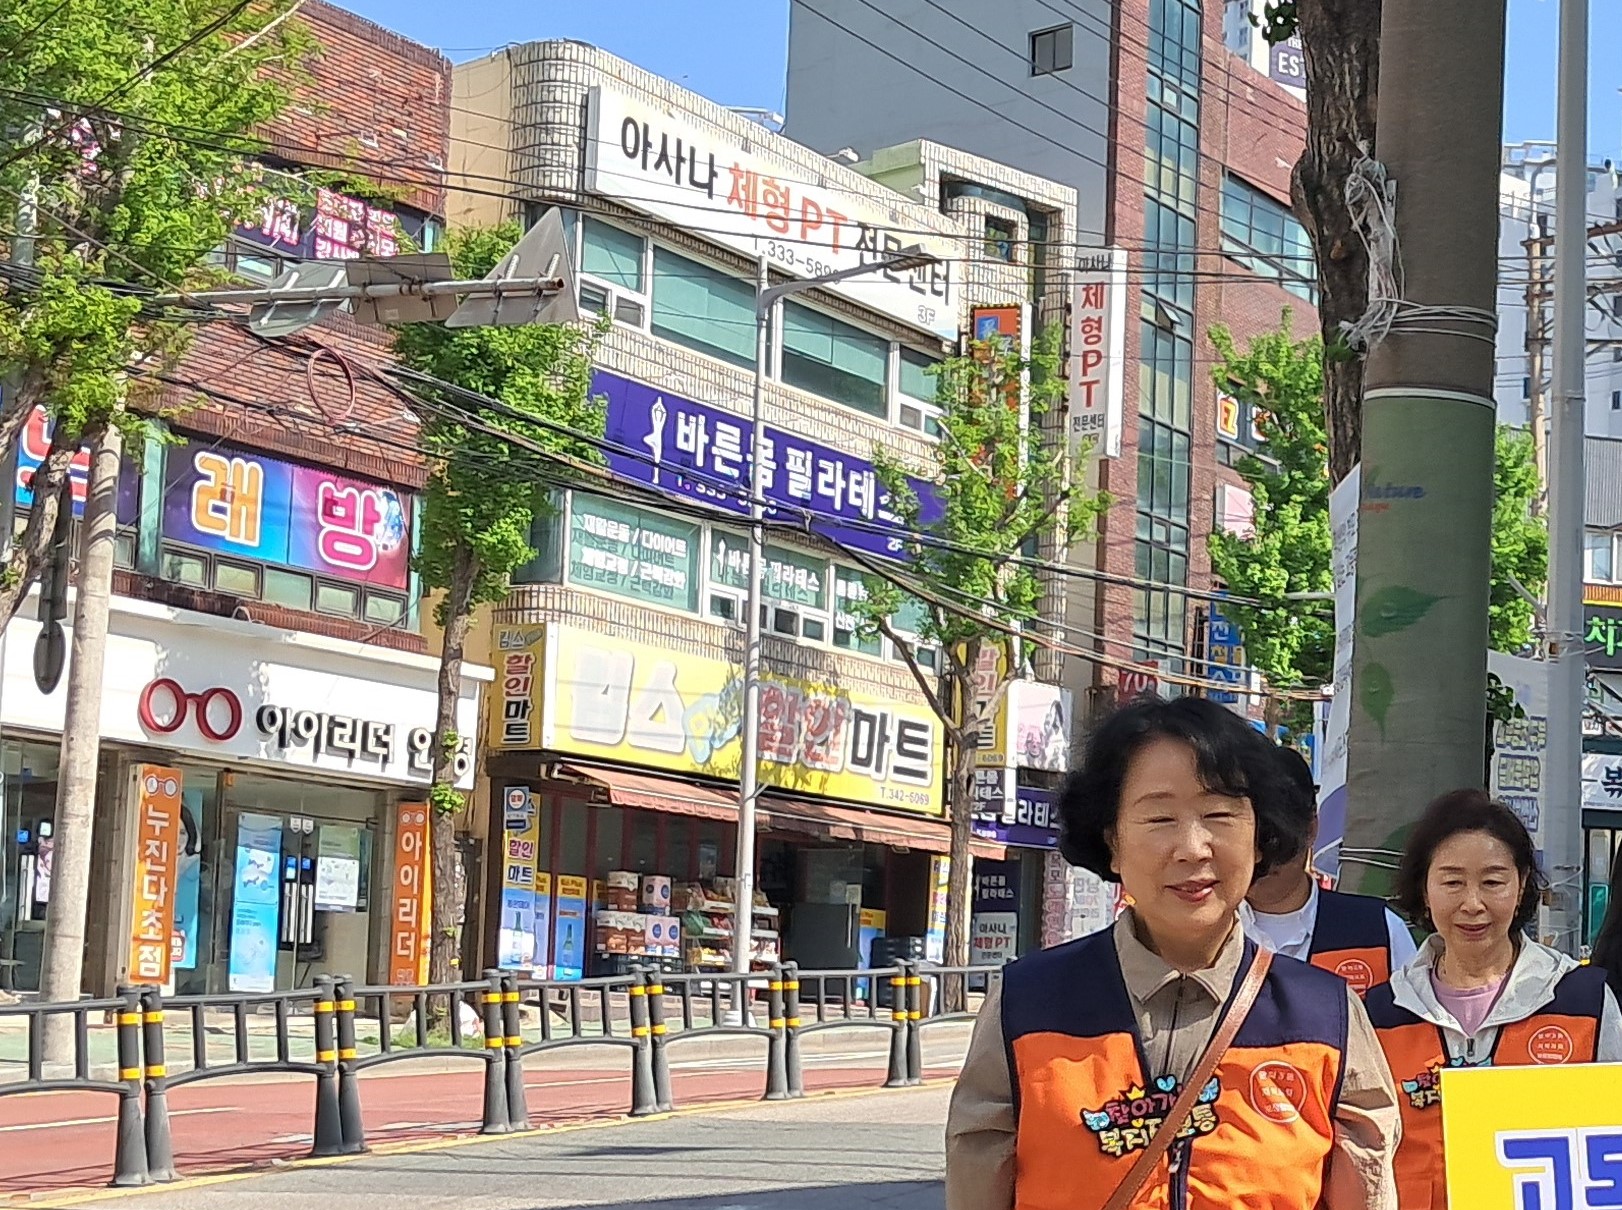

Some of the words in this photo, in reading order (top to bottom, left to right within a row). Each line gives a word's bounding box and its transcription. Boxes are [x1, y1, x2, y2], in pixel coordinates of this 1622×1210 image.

[1278, 52, 1306, 77] ES
[621, 116, 718, 199] 아사나
[918, 305, 936, 325] 3F
[1073, 413, 1105, 432] 전문센터
[642, 529, 687, 559] 다이어트
[503, 652, 537, 744] 할인마트
[256, 704, 396, 764] 아이리더
[508, 839, 535, 860] 할인
[508, 865, 535, 884] 마트
[138, 803, 171, 978] 누진다초점
[396, 831, 423, 962] 아이리더
[980, 923, 1007, 934] 아사나
